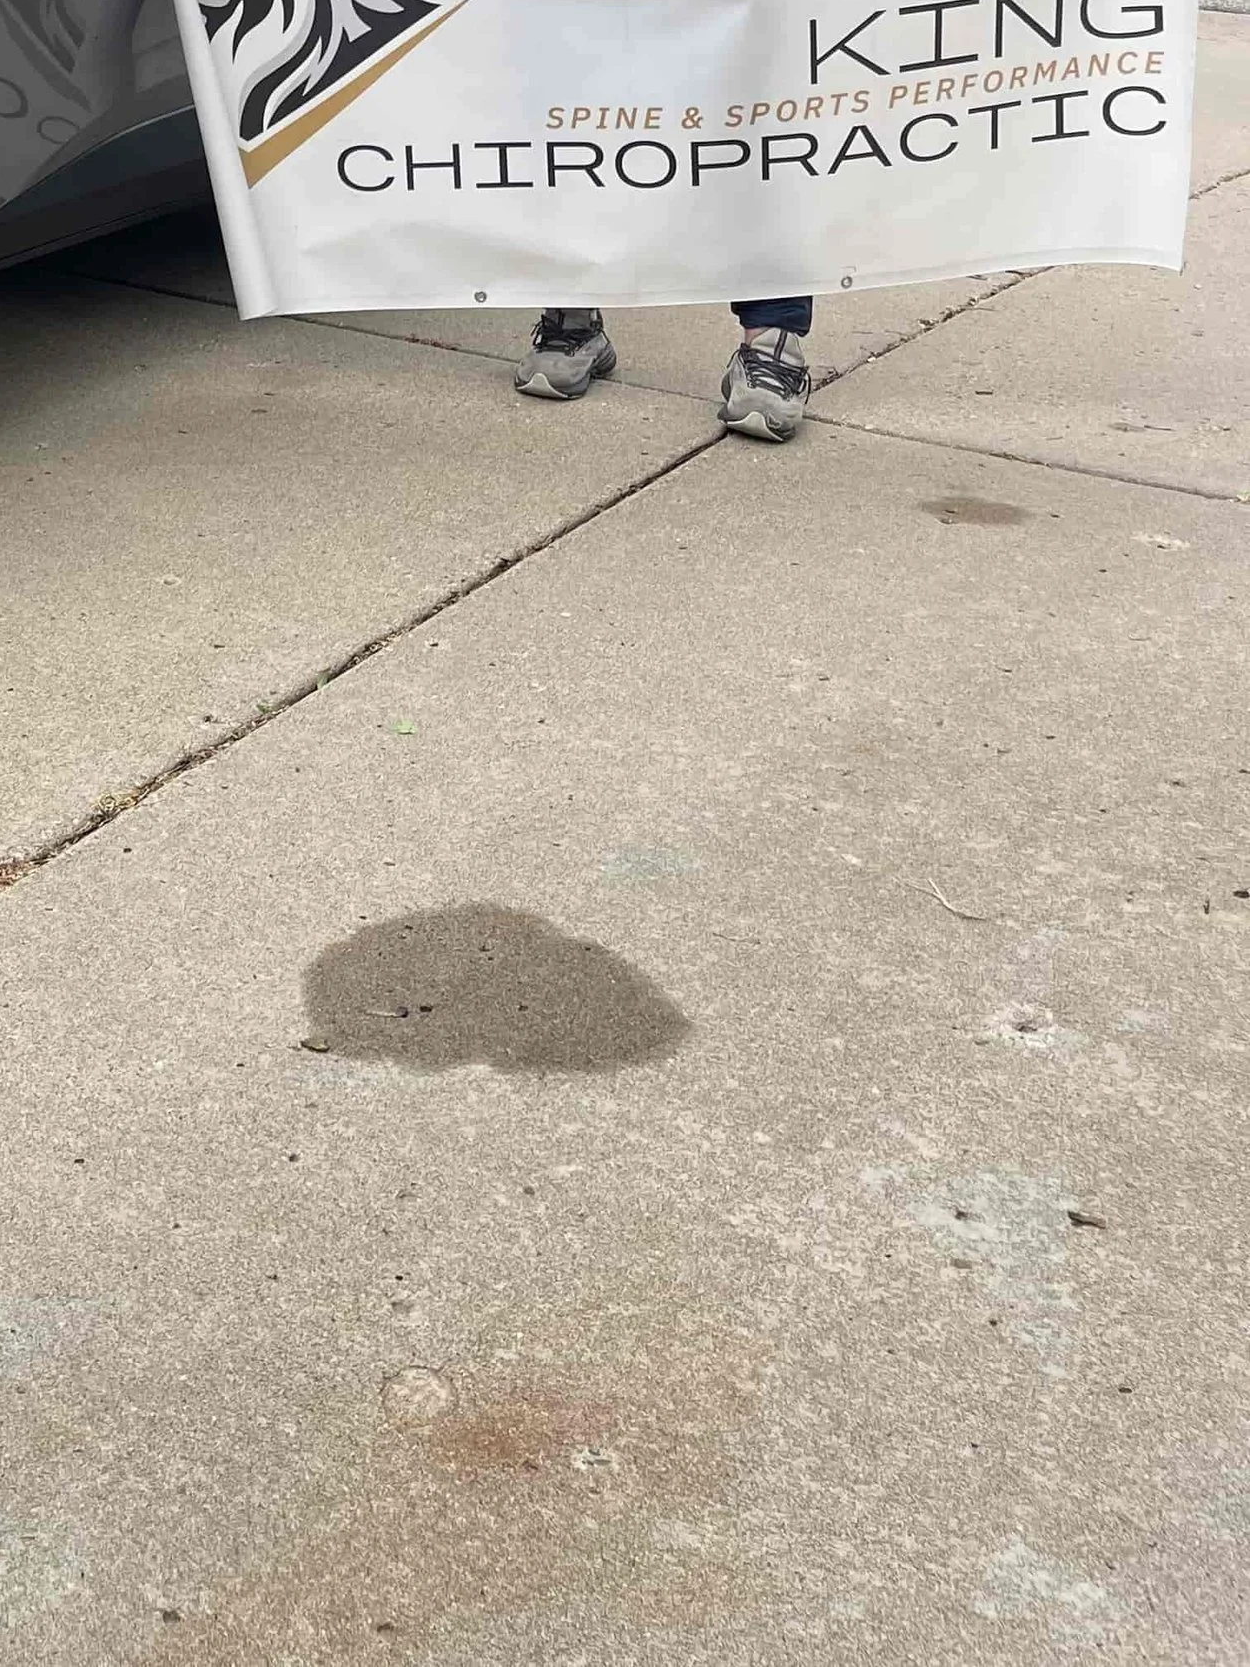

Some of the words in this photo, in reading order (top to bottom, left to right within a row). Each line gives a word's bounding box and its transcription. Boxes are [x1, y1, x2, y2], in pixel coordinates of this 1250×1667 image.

[545, 106, 664, 130] SPINE
[680, 106, 704, 130] &
[724, 90, 870, 128] SPORTS
[888, 50, 1166, 110] PERFORMANCE
[336, 85, 1168, 193] CHIROPRACTIC
